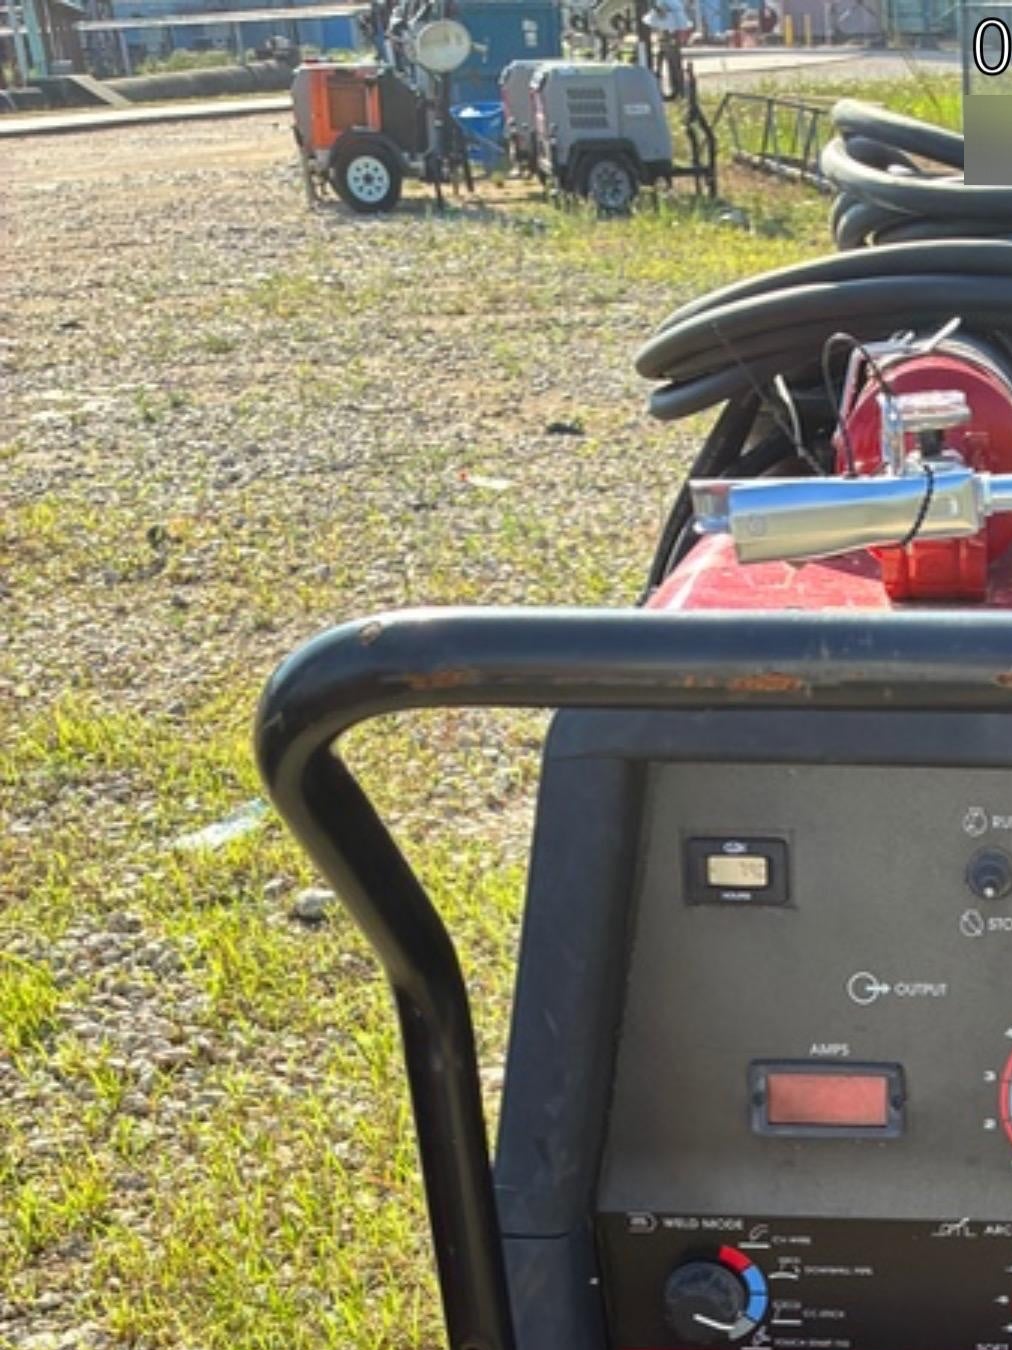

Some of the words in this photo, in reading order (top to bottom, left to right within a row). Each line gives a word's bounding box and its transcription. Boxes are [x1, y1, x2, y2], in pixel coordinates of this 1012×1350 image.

[893, 982, 947, 996] OUTPUT
[809, 1043, 850, 1057] AMPS
[984, 1069, 996, 1081] 3
[983, 1118, 996, 1130] 2
[663, 1218, 699, 1229] WELD
[702, 1218, 744, 1231] MODE
